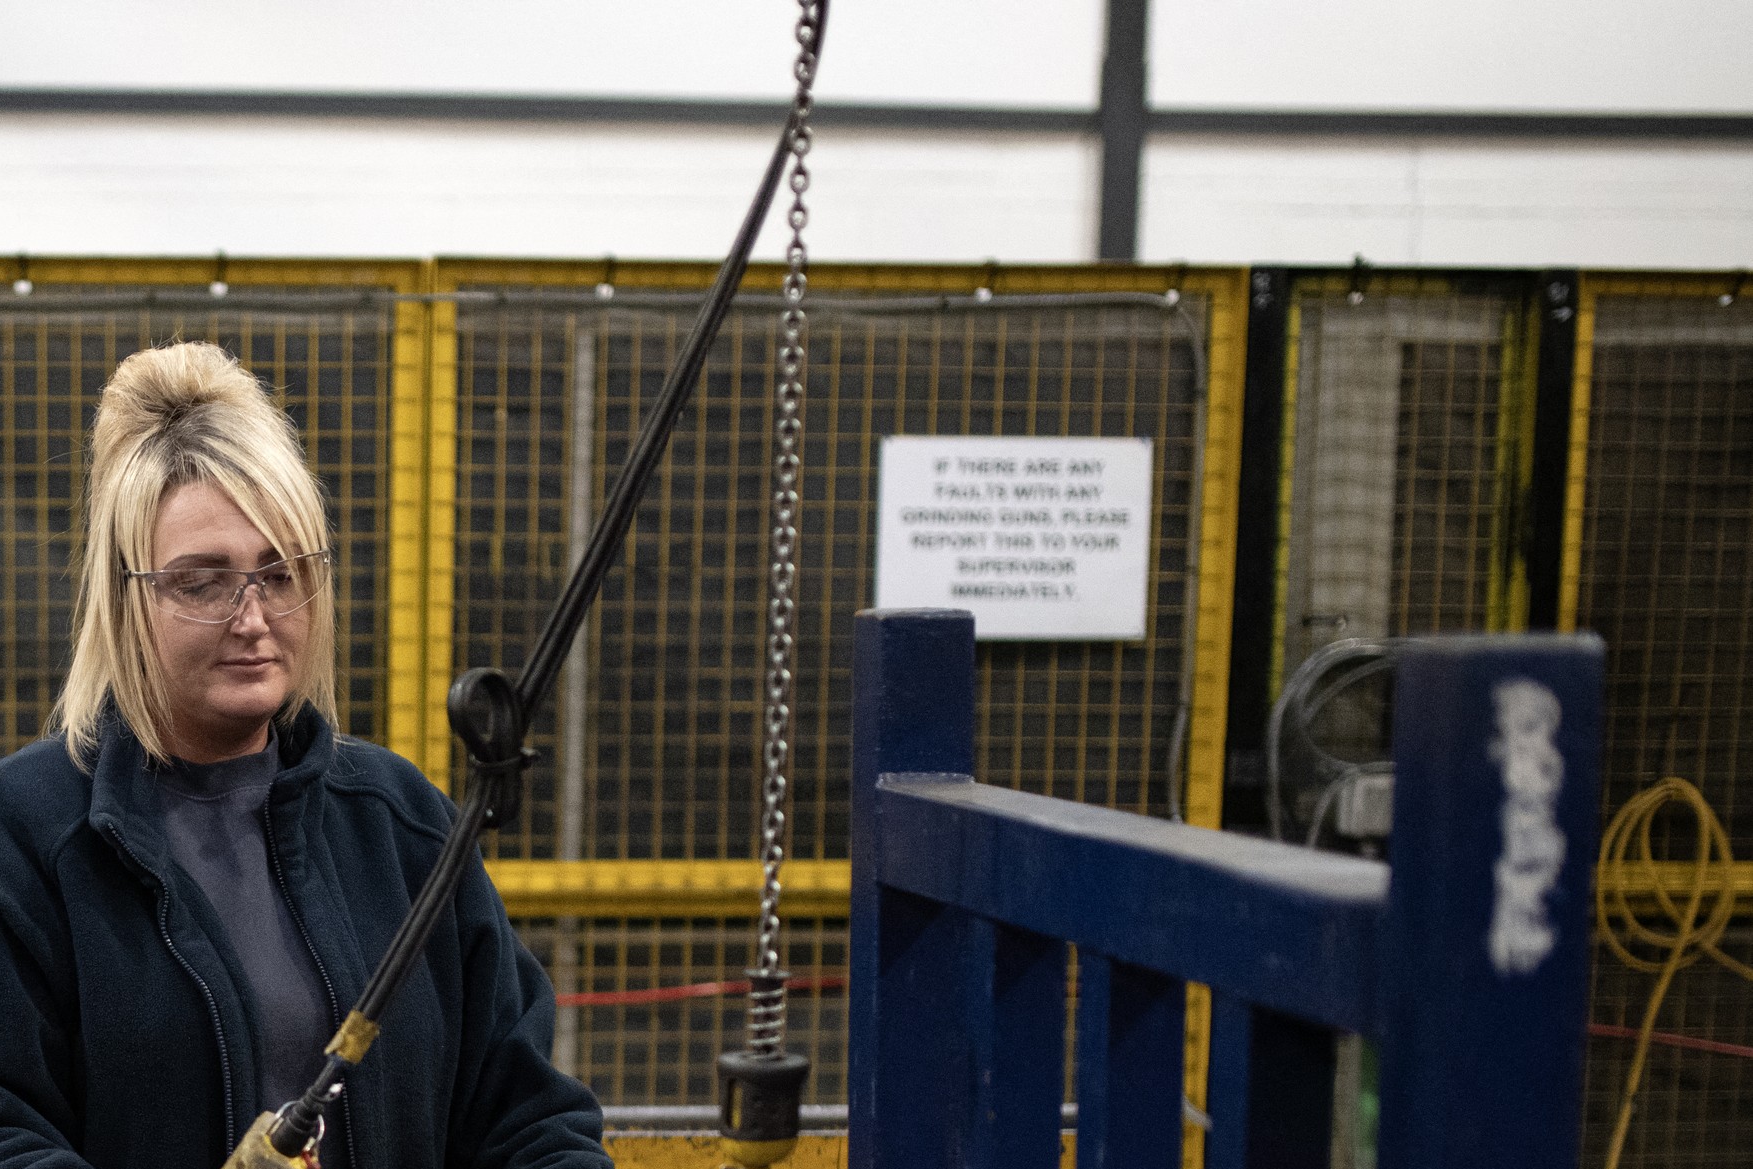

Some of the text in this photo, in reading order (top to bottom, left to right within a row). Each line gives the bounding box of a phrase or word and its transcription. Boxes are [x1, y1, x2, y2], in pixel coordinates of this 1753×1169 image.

[957, 457, 1017, 475] THERE
[1024, 457, 1061, 475] ARE
[1068, 458, 1105, 476] ANY
[934, 482, 1104, 500] FAULTS WITH ANY
[901, 507, 993, 525] GRINDING
[1061, 507, 1130, 525] PLEASE
[910, 532, 1120, 550] REPORT THIS TO YOUR
[956, 556, 1076, 574] SUPERVISOR
